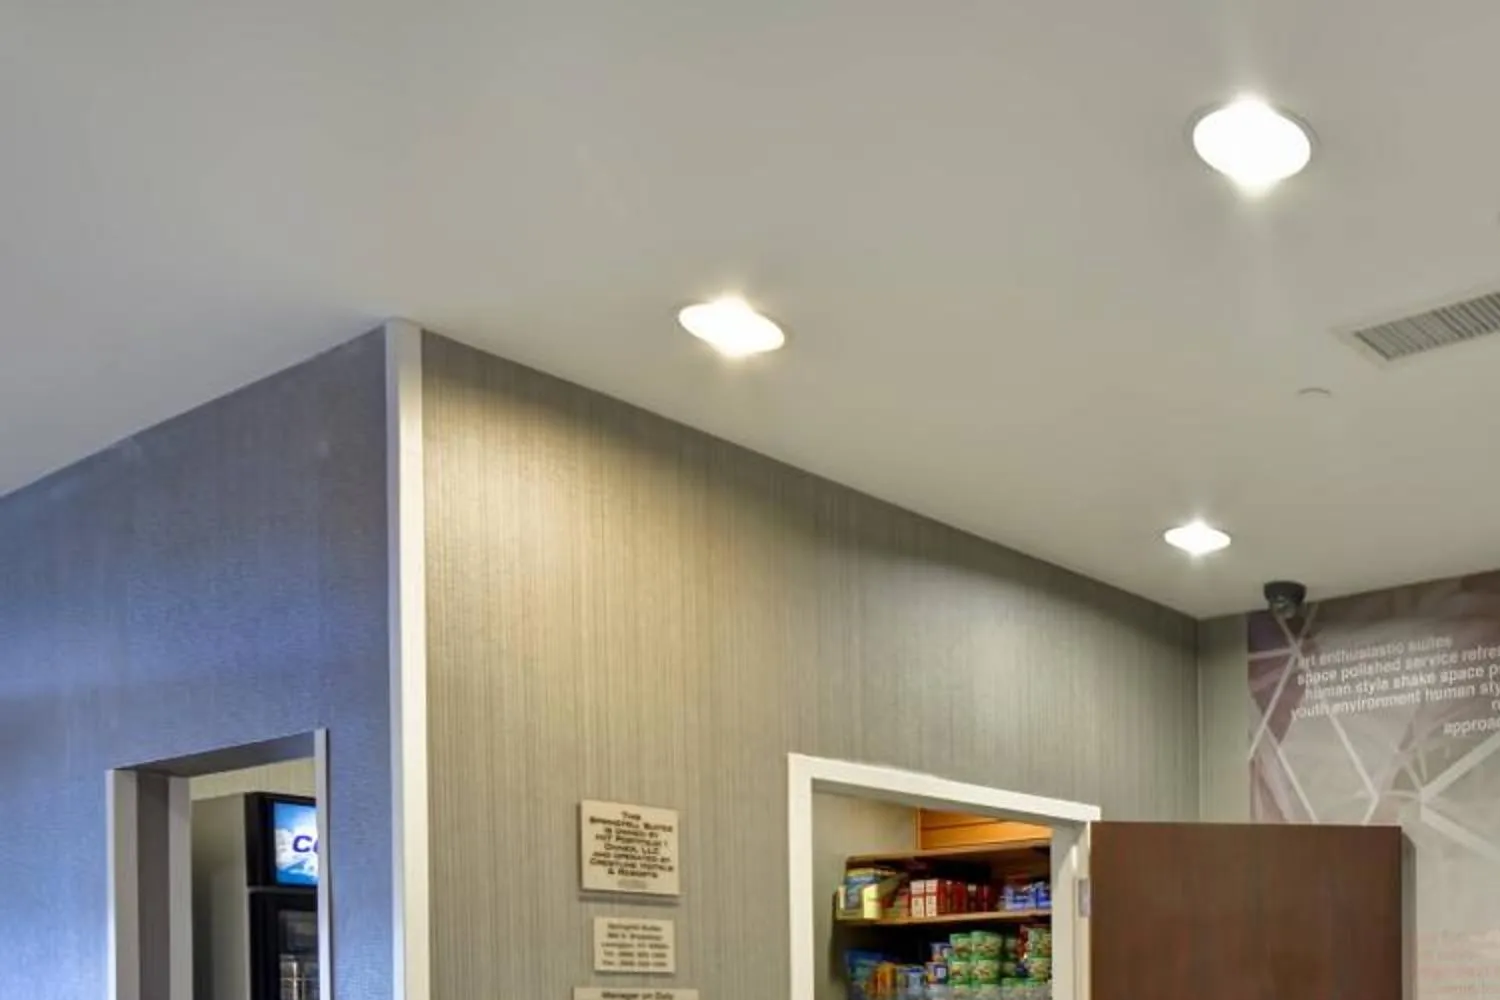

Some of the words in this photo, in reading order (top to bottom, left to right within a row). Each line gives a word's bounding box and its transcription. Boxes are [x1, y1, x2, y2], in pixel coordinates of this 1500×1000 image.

[1297, 669, 1335, 686] space
[1341, 657, 1400, 682] polished
[1405, 651, 1457, 670] service
[1356, 677, 1388, 695] style
[1393, 671, 1435, 689] shake
[1440, 666, 1483, 685] space
[1425, 685, 1475, 702] human
